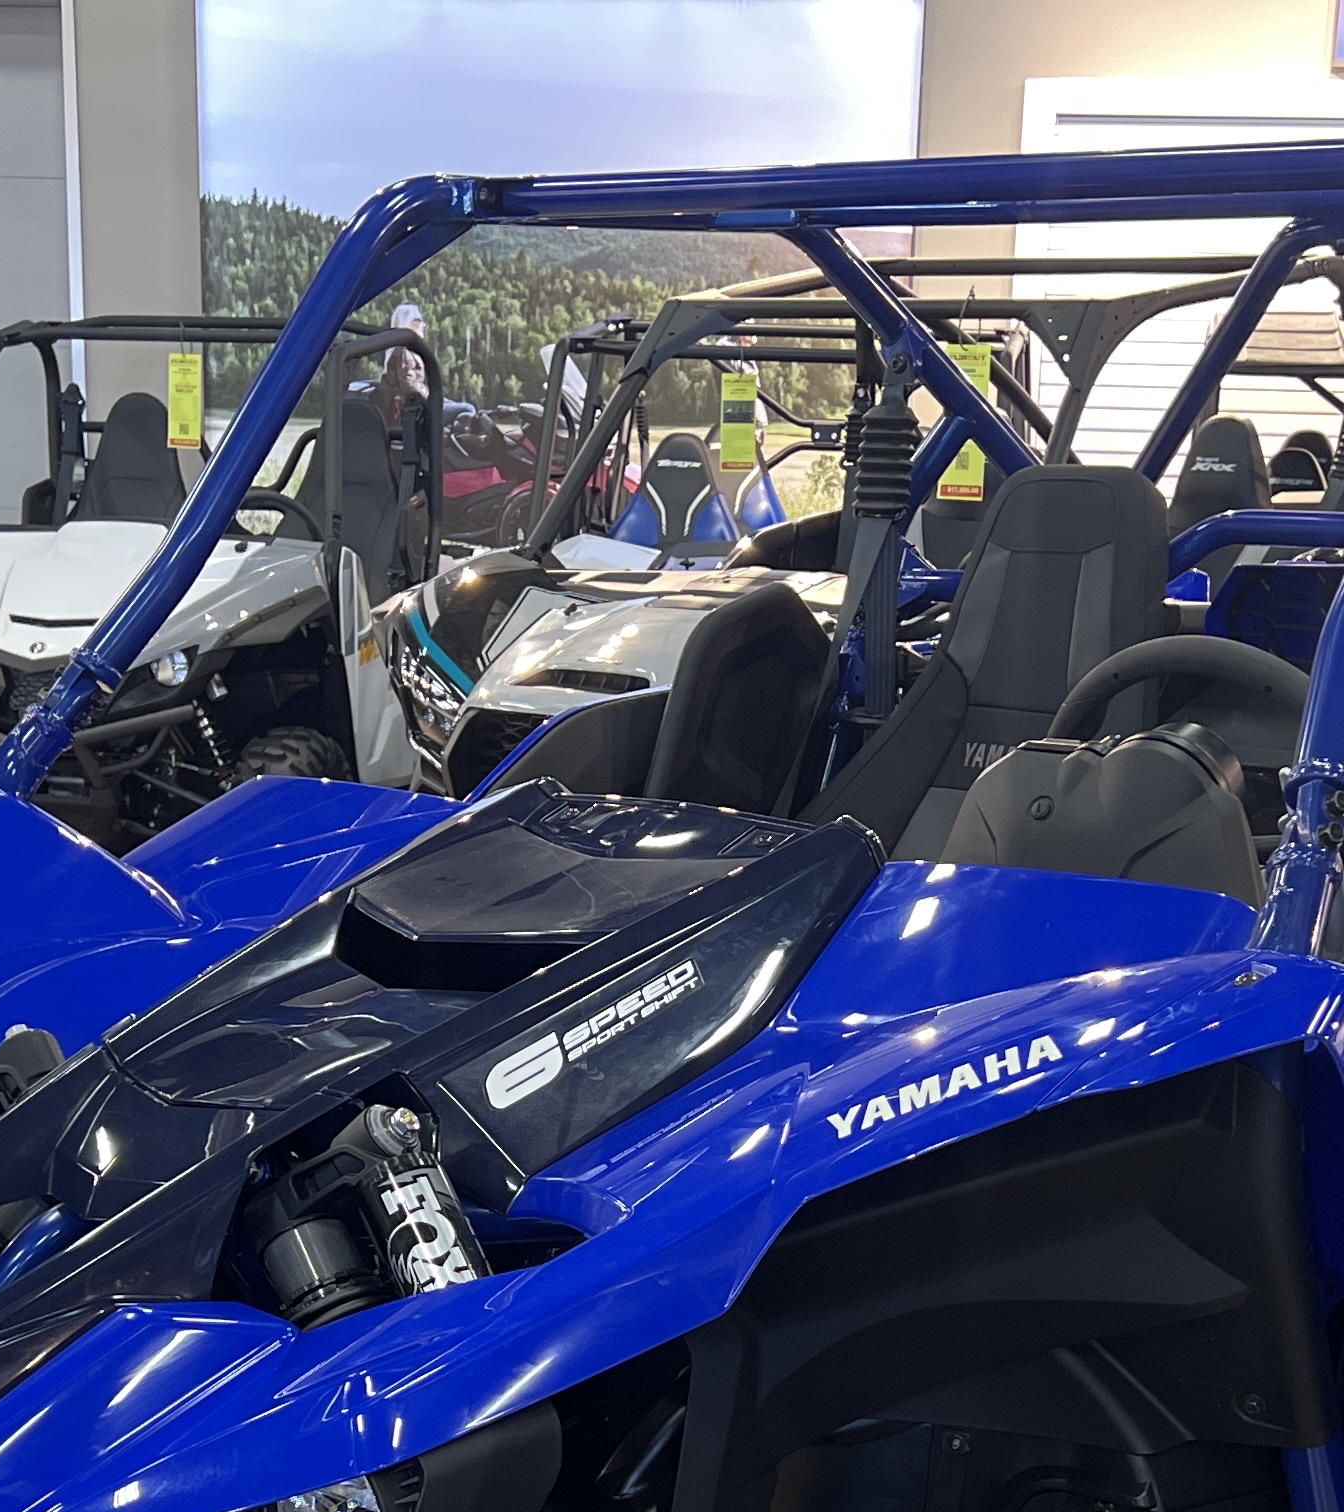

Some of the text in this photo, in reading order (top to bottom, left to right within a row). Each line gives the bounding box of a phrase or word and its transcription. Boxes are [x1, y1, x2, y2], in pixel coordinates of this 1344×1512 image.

[962, 741, 1016, 768] YAM
[562, 957, 697, 1051] SPEED
[567, 975, 700, 1063] SPORT SHIFT
[826, 1034, 1063, 1140] YAMAHA
